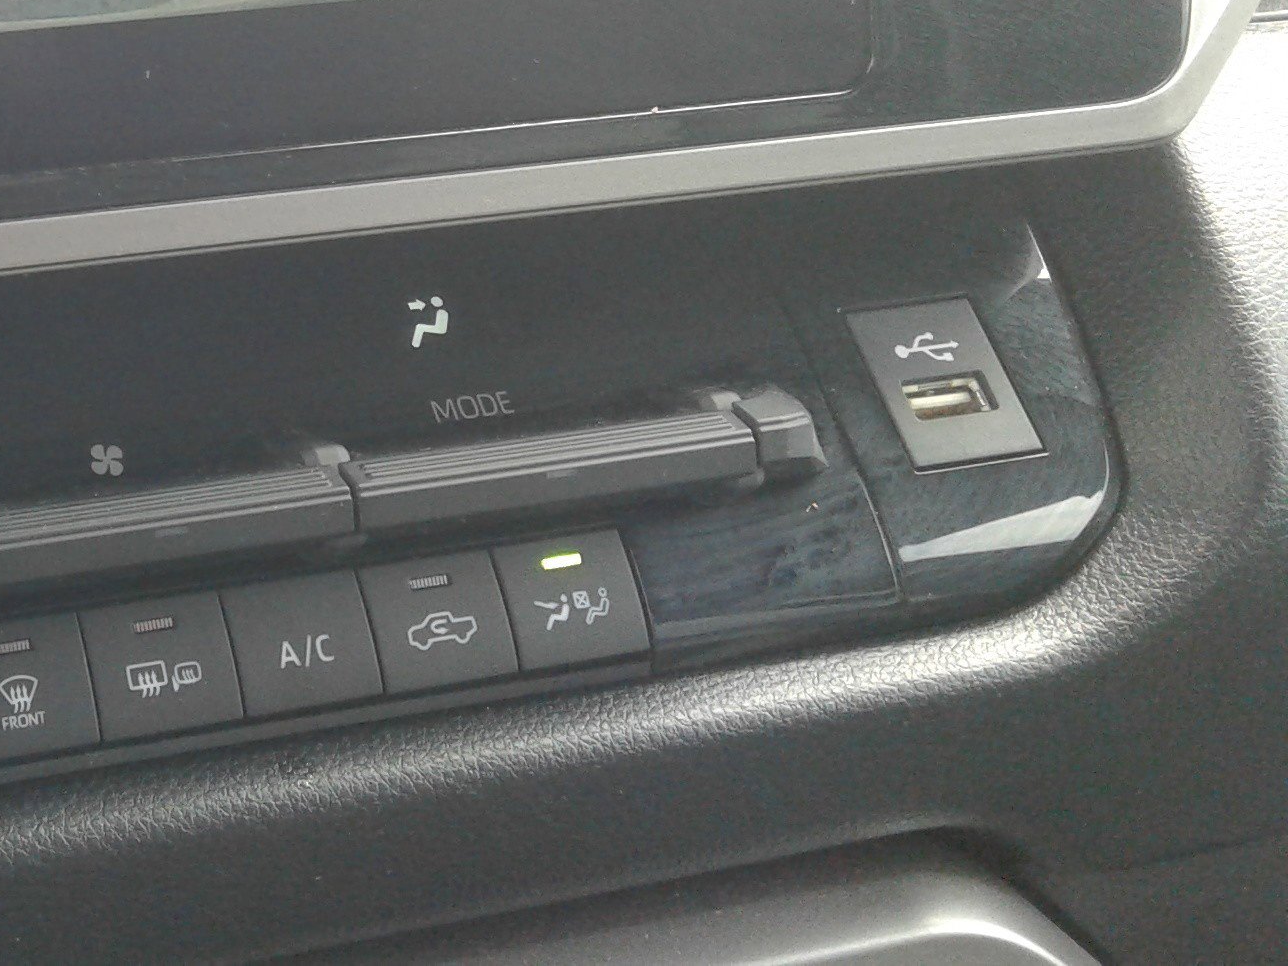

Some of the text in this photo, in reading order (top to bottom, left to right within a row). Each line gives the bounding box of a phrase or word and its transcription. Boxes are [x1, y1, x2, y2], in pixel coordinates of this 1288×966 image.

[430, 390, 516, 424] MODE
[279, 633, 336, 670] A/C
[0, 710, 47, 732] FRONT
